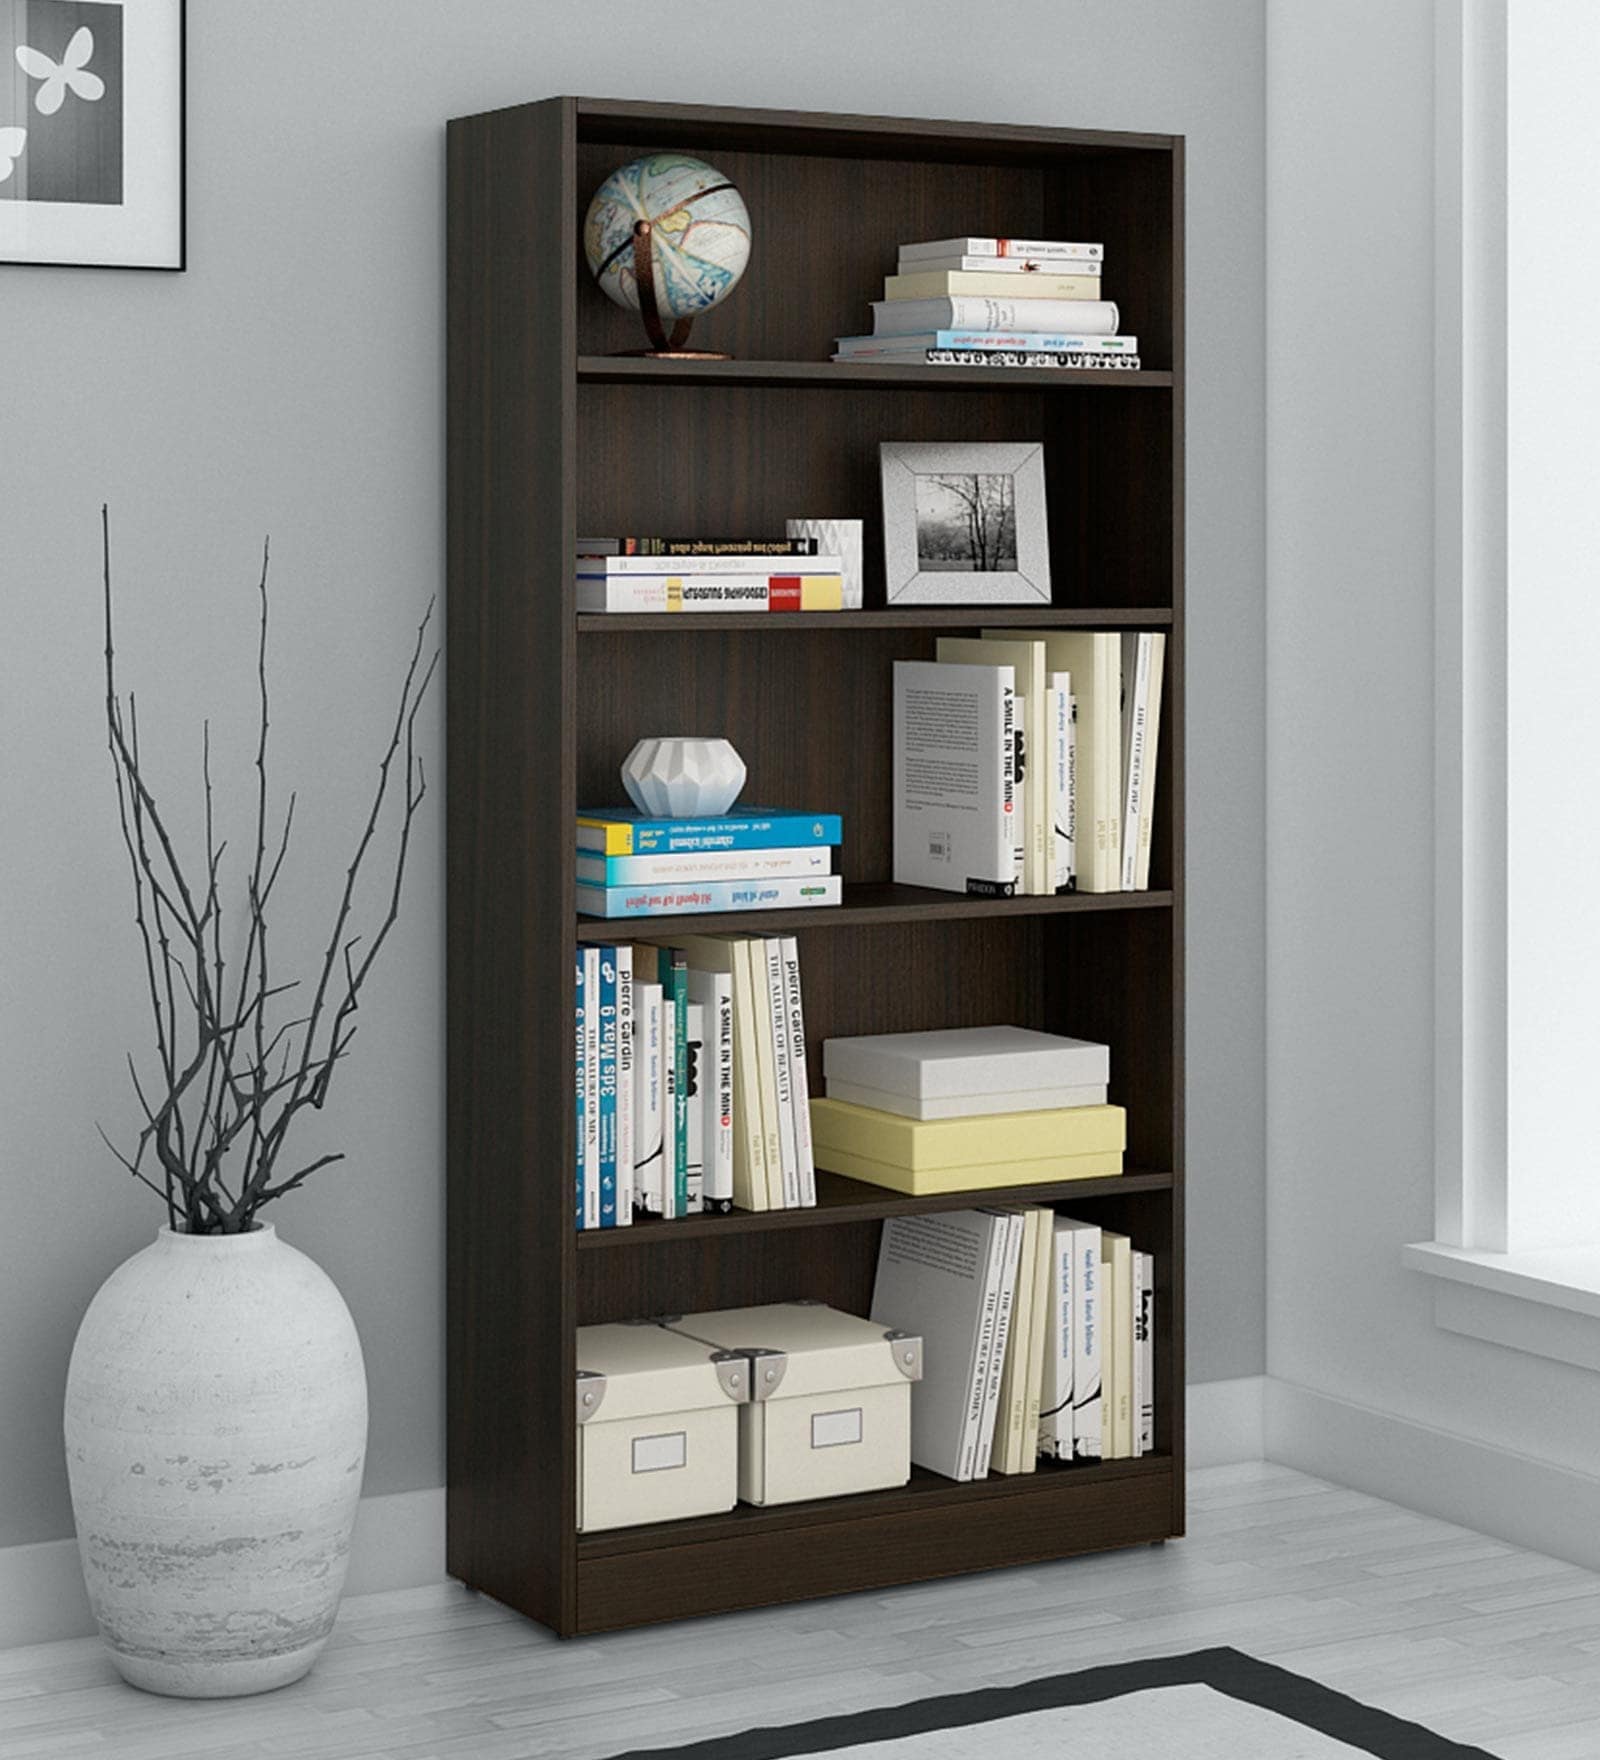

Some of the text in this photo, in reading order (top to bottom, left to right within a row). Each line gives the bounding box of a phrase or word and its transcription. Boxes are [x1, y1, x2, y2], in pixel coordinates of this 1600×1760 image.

[1004, 687, 1014, 696] A
[1004, 700, 1014, 735] SMILE
[1004, 739, 1013, 750] IN
[1004, 755, 1013, 777] THE
[1003, 780, 1013, 813] MIND
[720, 996, 731, 1005] A
[786, 961, 804, 1058] pierre cardin
[619, 970, 633, 1071] pierre cardin
[720, 1008, 731, 1045] SMILE
[770, 955, 790, 1104] THE ALLURE OF BEAUTY
[588, 1029, 597, 1050] THE
[601, 1006, 616, 1097] 3ds Max 9
[720, 1049, 731, 1063] IN
[720, 1066, 731, 1089] THE
[588, 1101, 597, 1115] OF
[720, 1092, 731, 1127] MIND
[588, 1118, 597, 1145] MEN
[971, 1291, 997, 1421] THE ALLURE OF WOMEN
[988, 1291, 1011, 1400] THE ALLURE OF MEN
